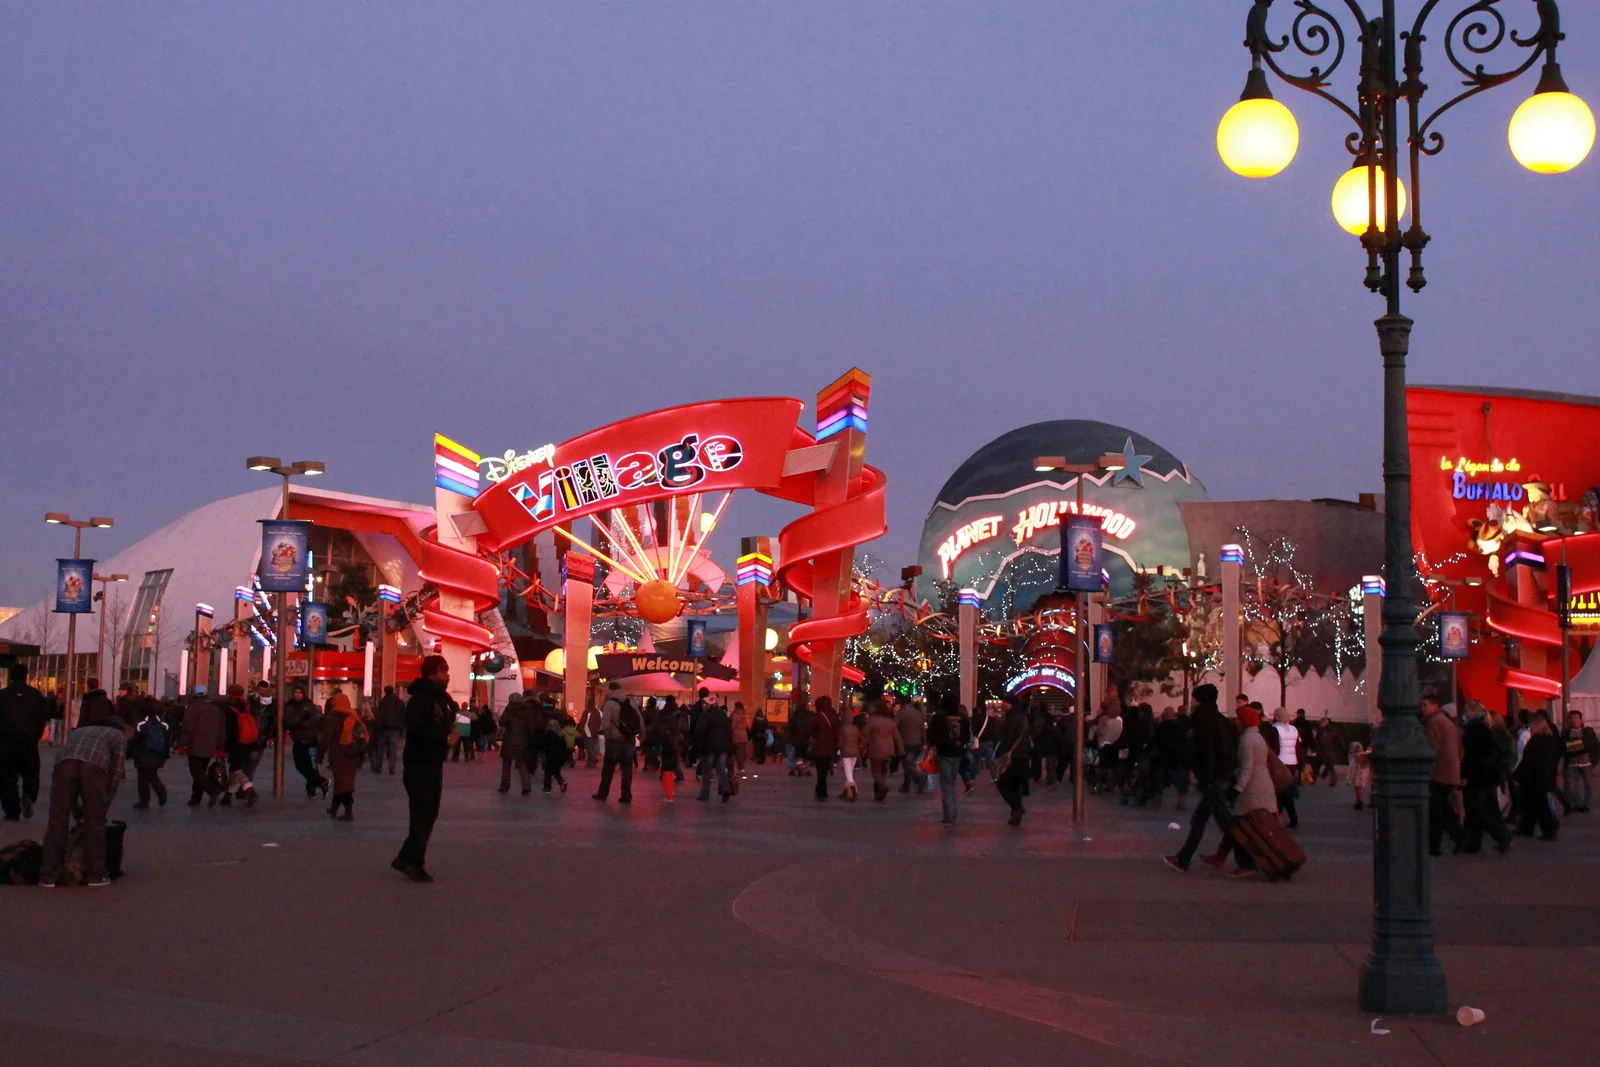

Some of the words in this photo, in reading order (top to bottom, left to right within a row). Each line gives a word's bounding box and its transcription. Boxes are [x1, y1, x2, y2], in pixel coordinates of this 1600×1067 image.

[476, 443, 555, 483] Disney
[509, 434, 743, 522] Village
[937, 515, 1003, 579] PLANET
[632, 656, 704, 673] Welcome
